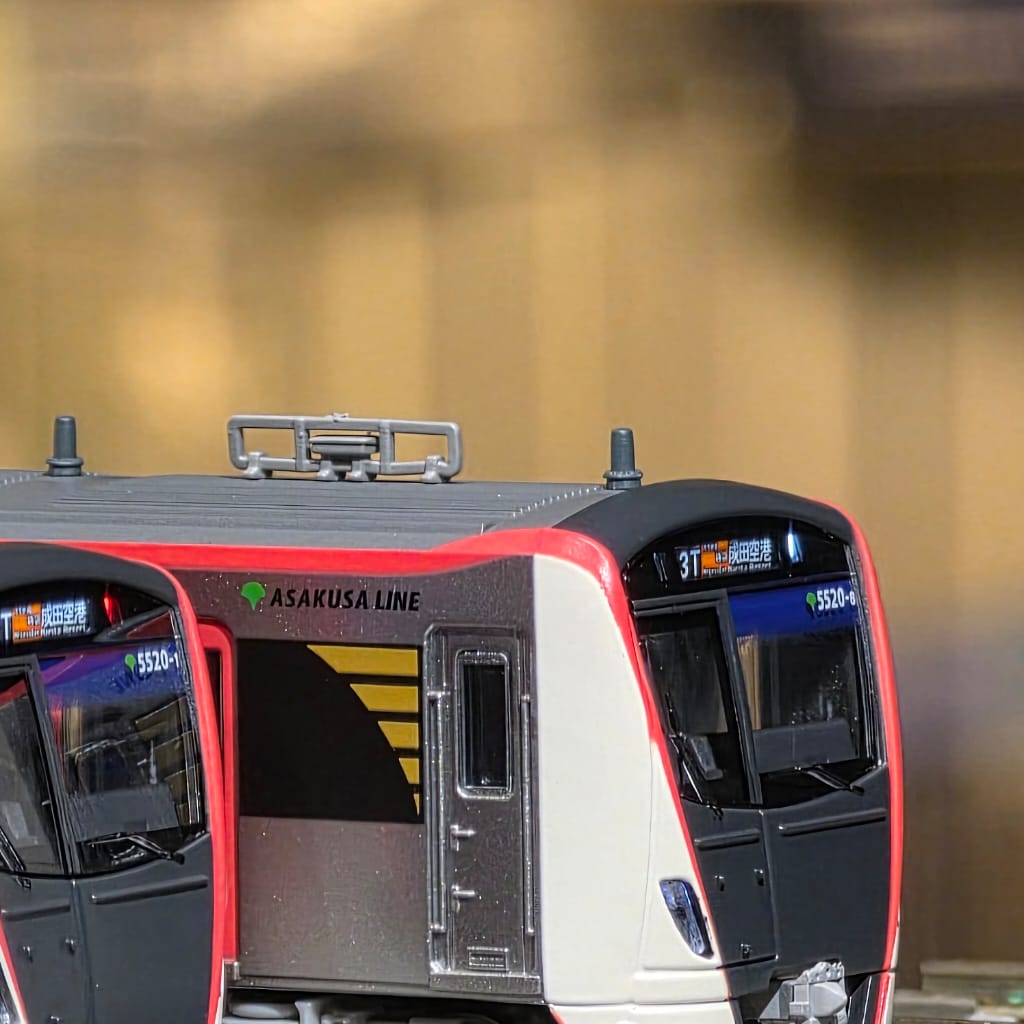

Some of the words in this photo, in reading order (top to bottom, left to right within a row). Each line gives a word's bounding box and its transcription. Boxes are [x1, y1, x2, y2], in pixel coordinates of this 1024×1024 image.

[728, 538, 772, 565] 成田空港
[270, 587, 369, 610] ASAKUSA
[375, 589, 421, 611] LINE
[41, 599, 87, 628] 成田空港
